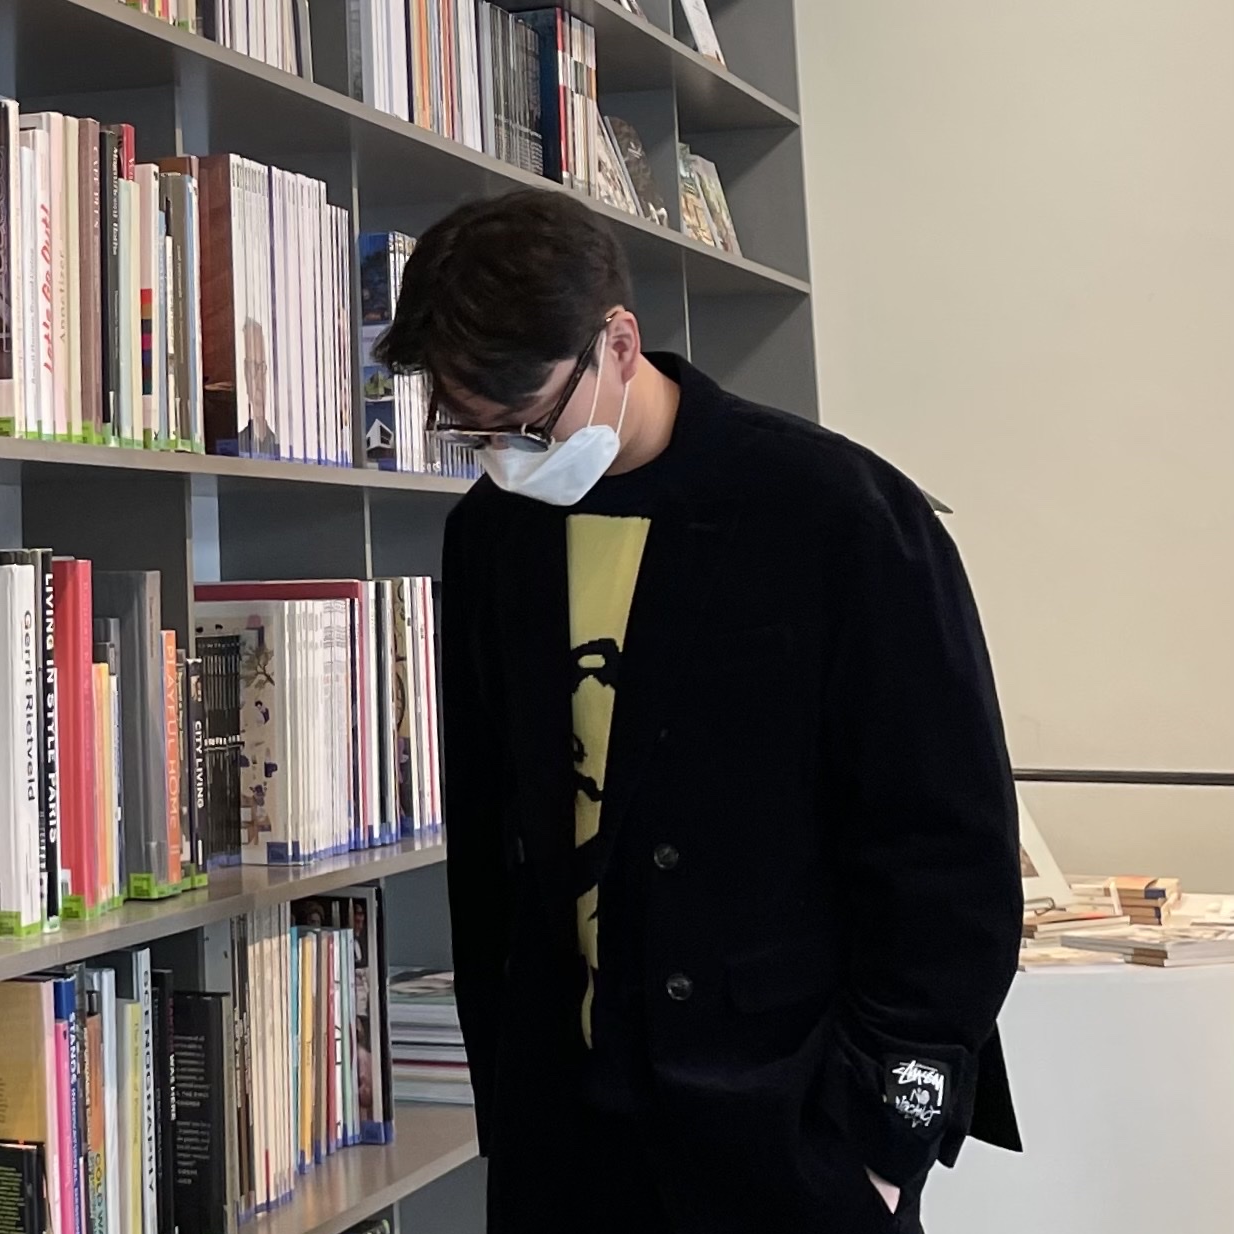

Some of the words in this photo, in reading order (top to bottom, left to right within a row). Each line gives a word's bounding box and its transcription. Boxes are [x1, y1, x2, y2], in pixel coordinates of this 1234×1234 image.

[23, 609, 33, 687] Gerrit
[45, 572, 55, 651] LIVING
[46, 659, 56, 682] IN
[166, 644, 176, 755] PLAYFUL
[25, 692, 36, 802] Rietveld
[46, 691, 57, 764] STYLE
[194, 720, 202, 754] CITY
[48, 772, 58, 844] PARIS
[195, 757, 204, 809] LIVING
[68, 1010, 78, 1084] STANDS
[143, 969, 155, 1193] SCENOGRAPHY
[94, 1152, 104, 1208] COLD
